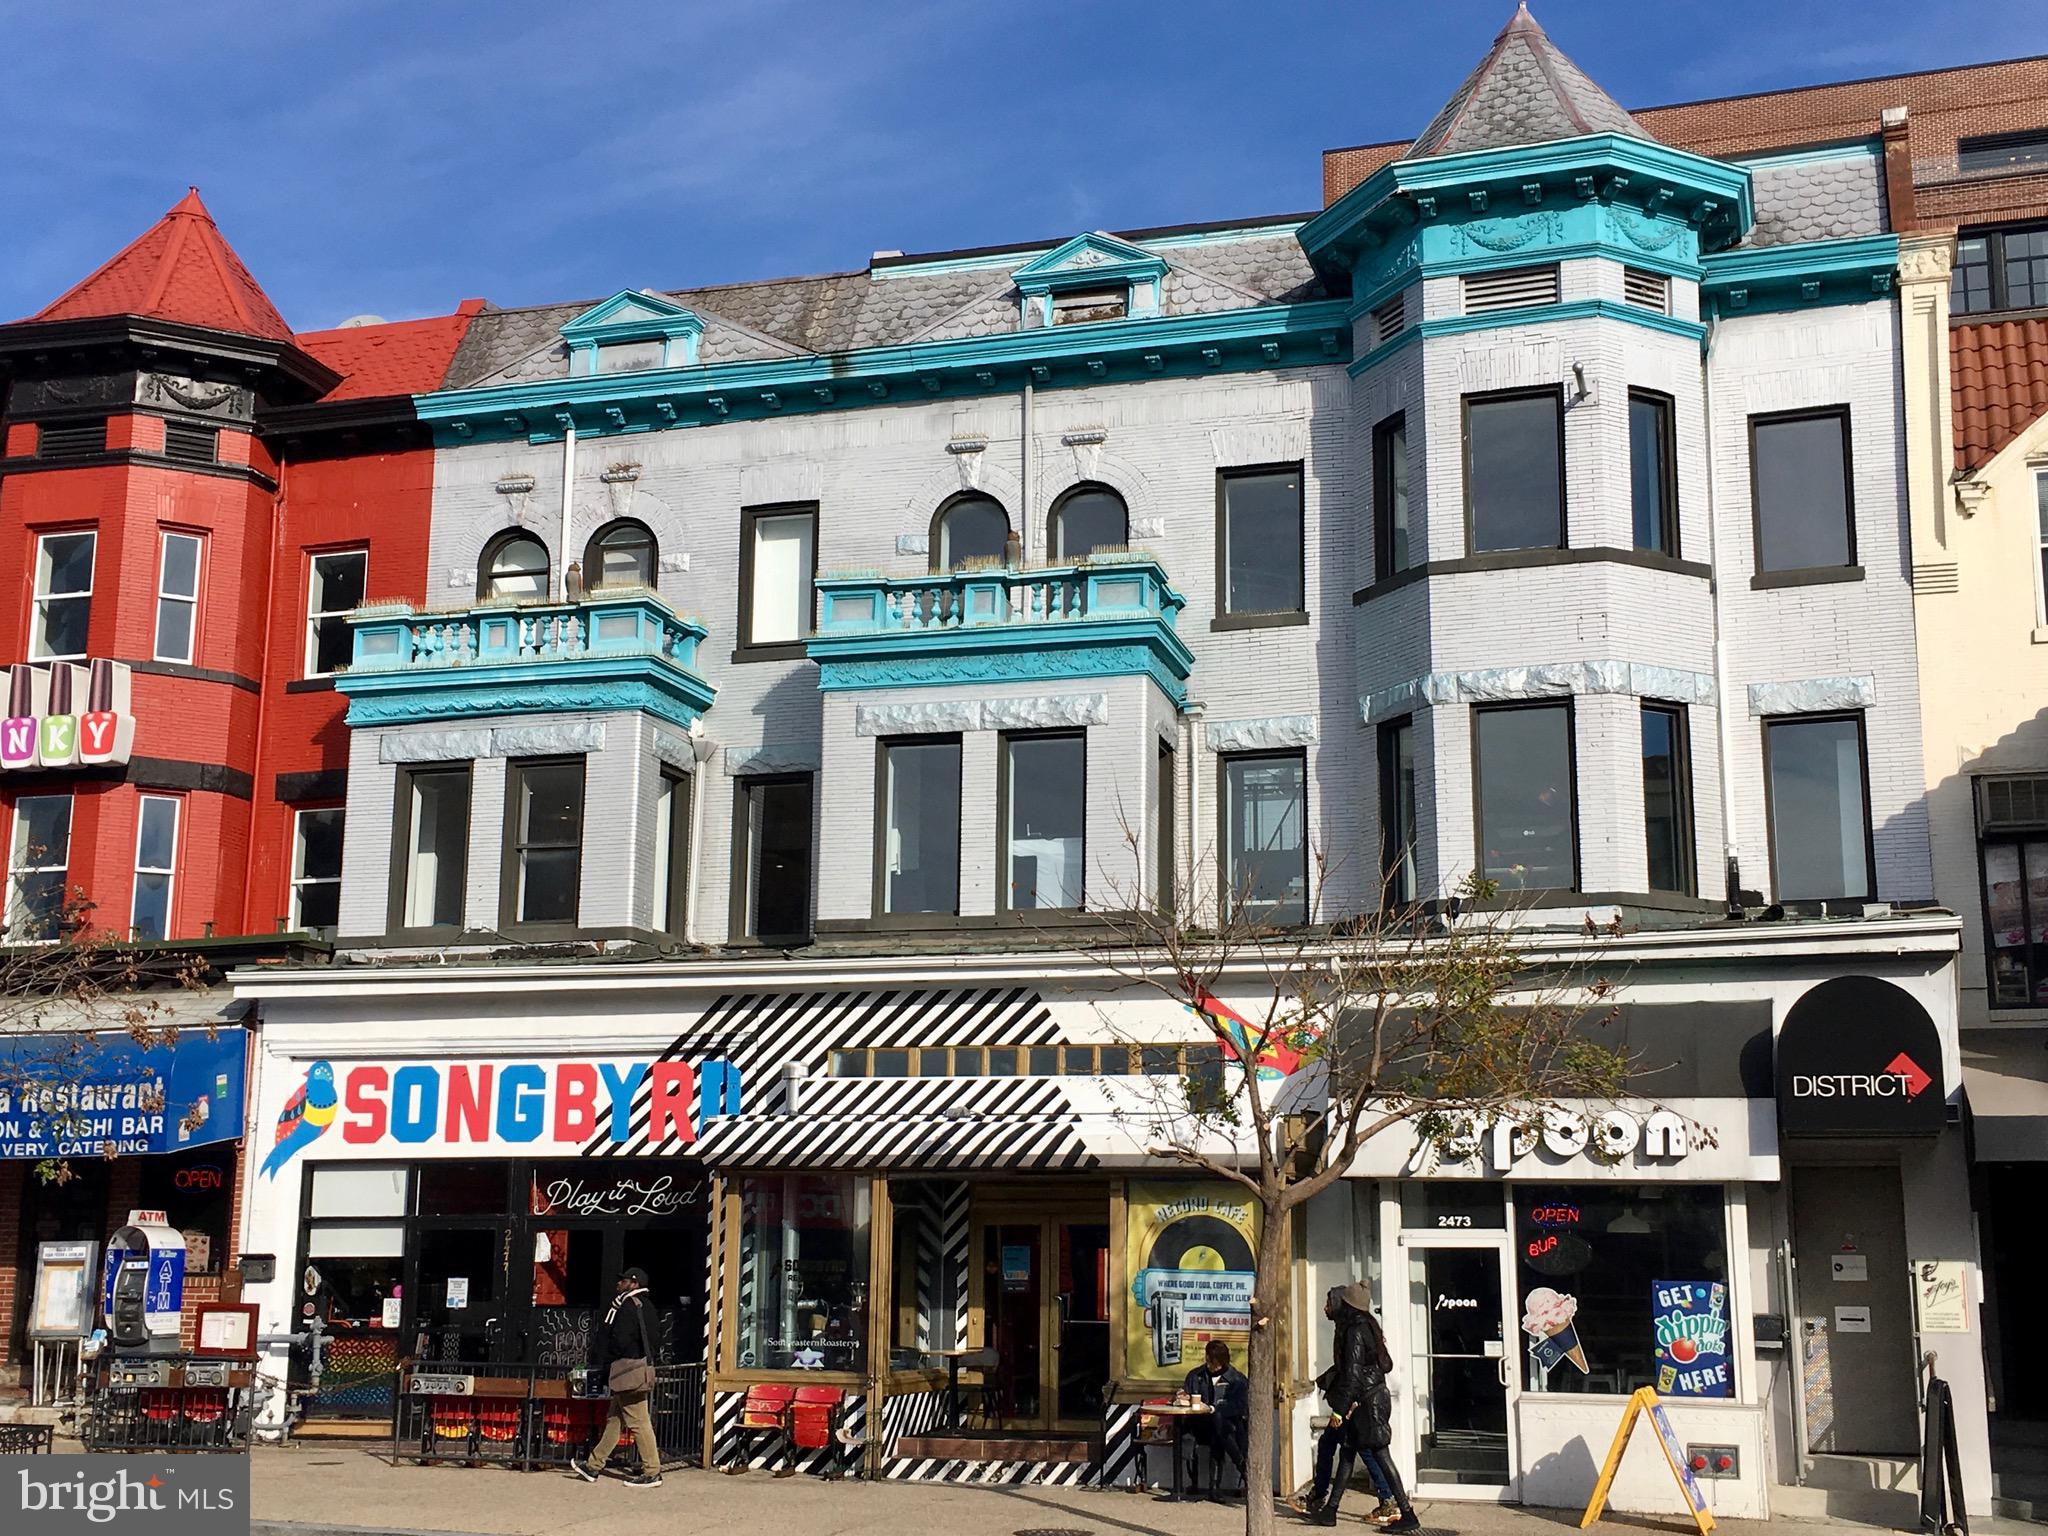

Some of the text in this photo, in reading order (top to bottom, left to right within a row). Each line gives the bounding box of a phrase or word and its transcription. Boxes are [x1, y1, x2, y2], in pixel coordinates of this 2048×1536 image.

[1793, 1074, 1913, 1097] DISTRICT
[342, 1061, 742, 1145] SONGBYRD
[121, 1115, 164, 1134] BAR
[58, 1138, 149, 1155] CATEING
[175, 1169, 222, 1188] OPEN
[536, 1175, 702, 1216] Play it Loud
[138, 1211, 165, 1222] ATM
[1438, 1215, 1472, 1227] 2473
[1532, 1208, 1580, 1223] OPEN
[157, 1260, 173, 1310] ATM
[1658, 1284, 1693, 1308] GET
[1695, 1338, 1725, 1354] dots
[1678, 1364, 1728, 1392] HERE
